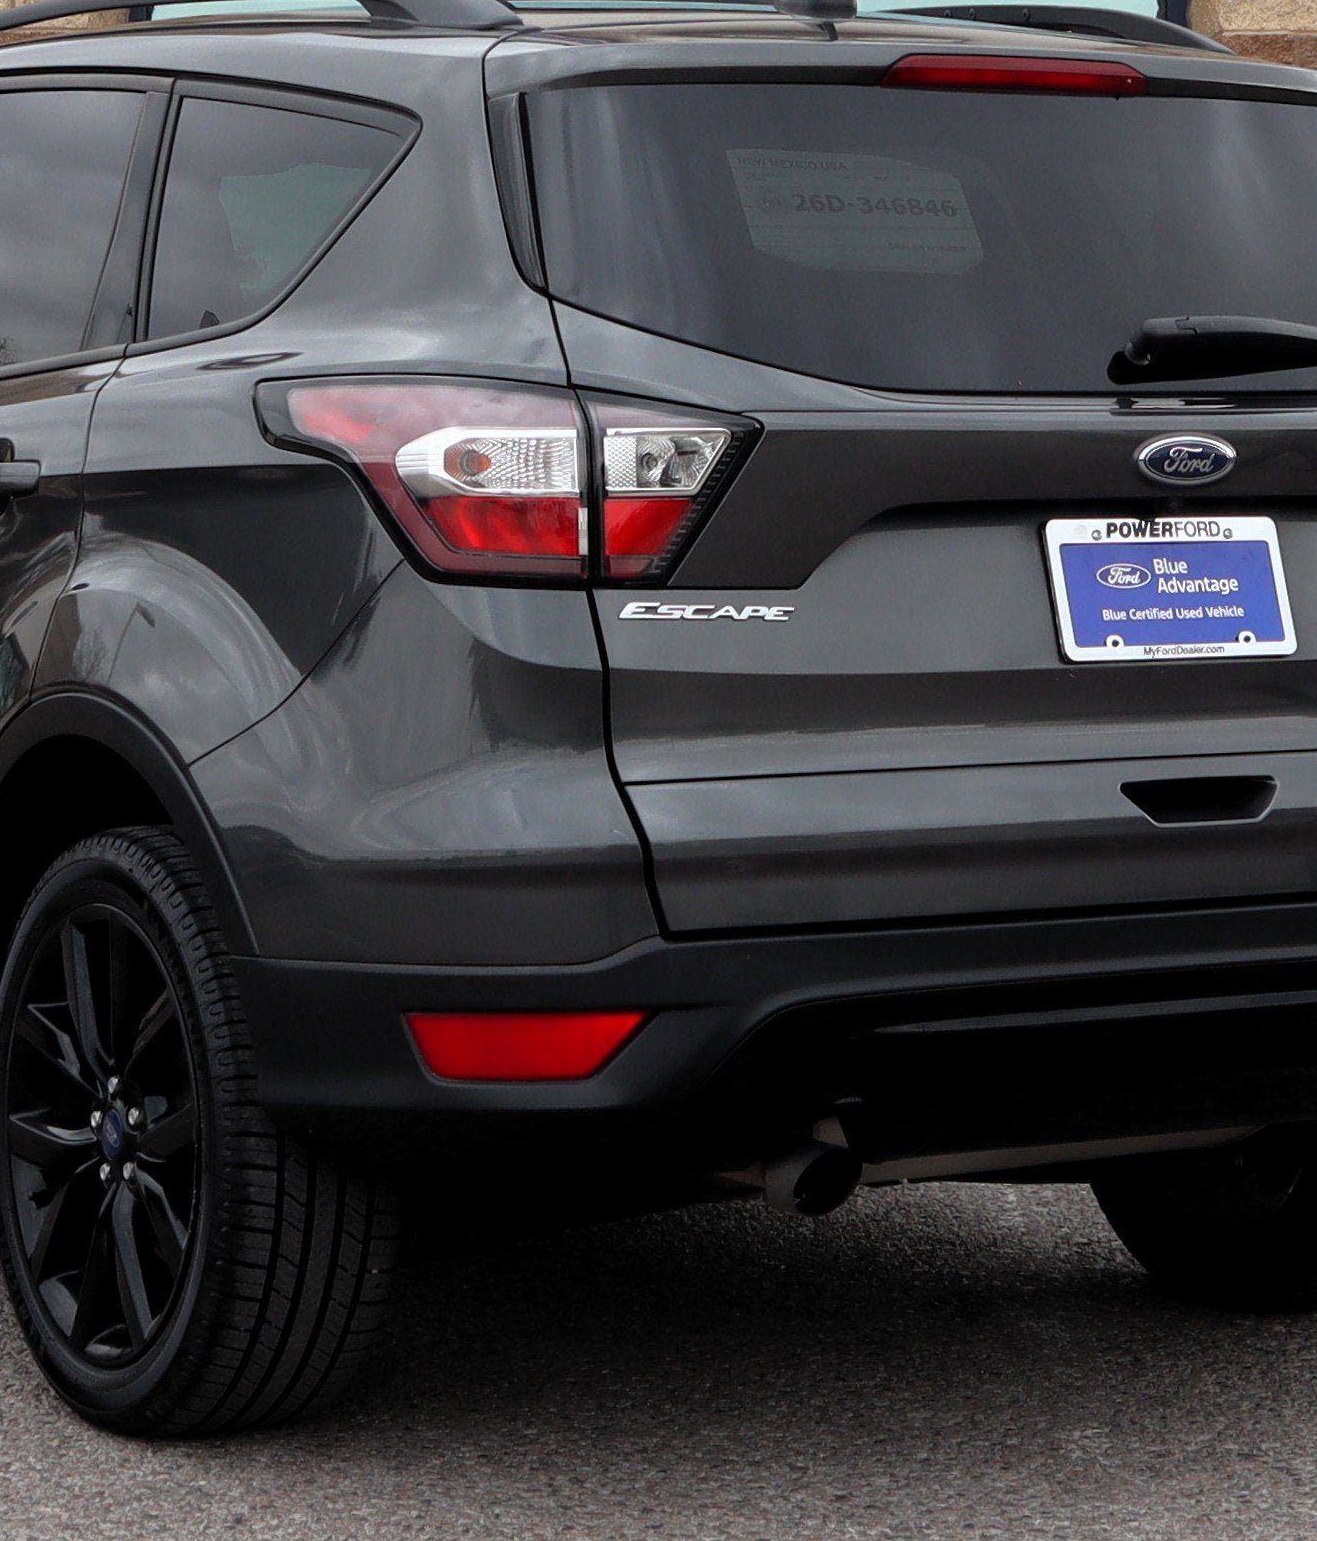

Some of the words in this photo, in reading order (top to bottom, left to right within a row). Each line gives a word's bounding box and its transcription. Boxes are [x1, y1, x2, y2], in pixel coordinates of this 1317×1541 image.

[791, 193, 958, 218] 26D-346846
[1163, 446, 1215, 474] Ford
[1107, 566, 1141, 585] Ford
[1152, 557, 1188, 575] Blue
[1157, 576, 1239, 595] Advantage
[618, 602, 795, 621] ESCAPE
[1102, 609, 1127, 621] Blue
[1129, 607, 1173, 620] Certified
[1176, 606, 1204, 619] Used
[1205, 604, 1245, 618] Vehicle
